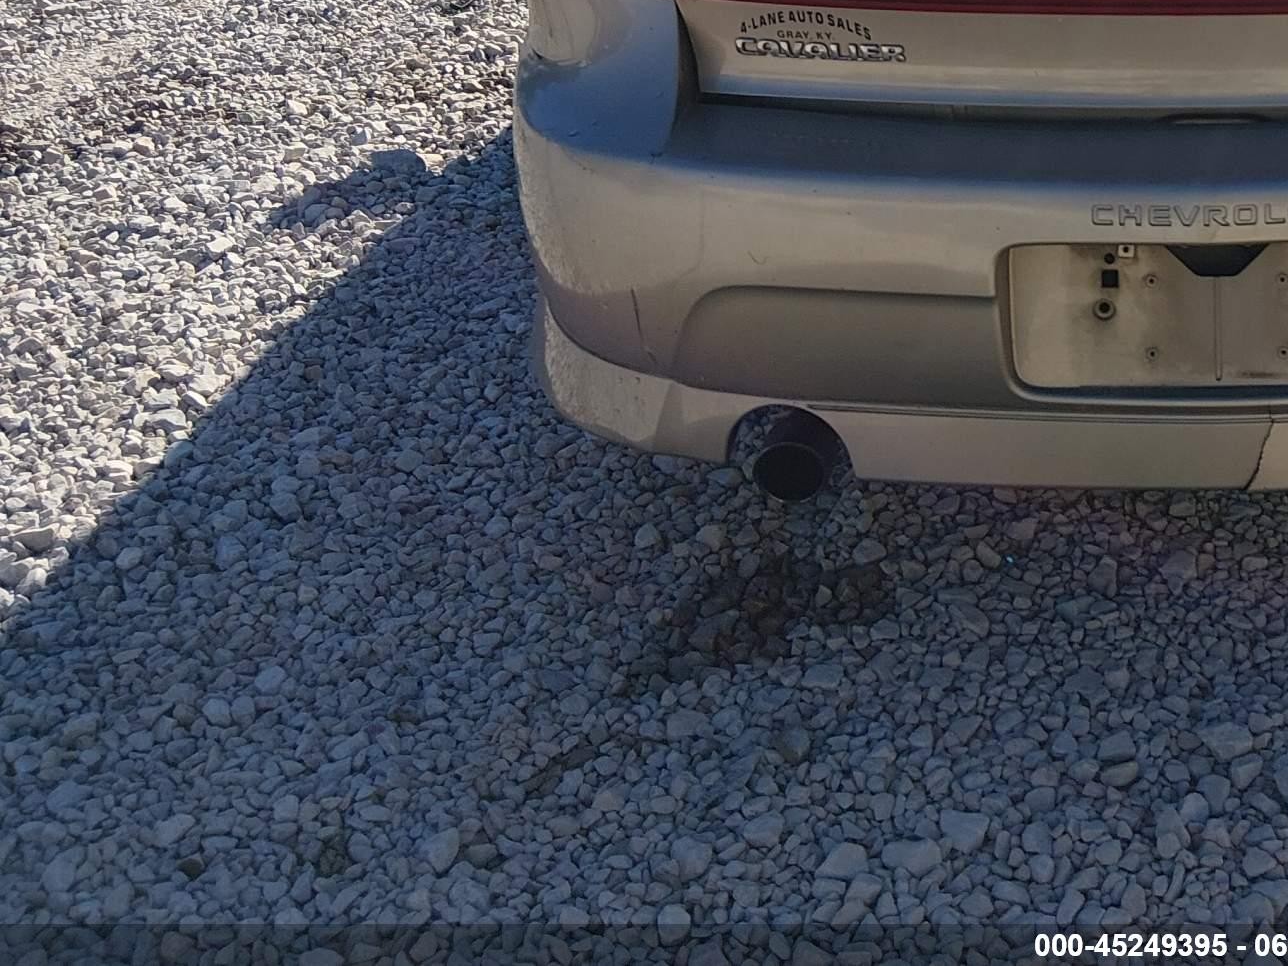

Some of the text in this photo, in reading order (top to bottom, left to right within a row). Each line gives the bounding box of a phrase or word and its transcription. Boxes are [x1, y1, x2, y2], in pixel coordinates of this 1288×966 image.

[789, 11, 824, 25] AUTO
[828, 14, 872, 40] SALES
[735, 36, 907, 62] CAVALIER
